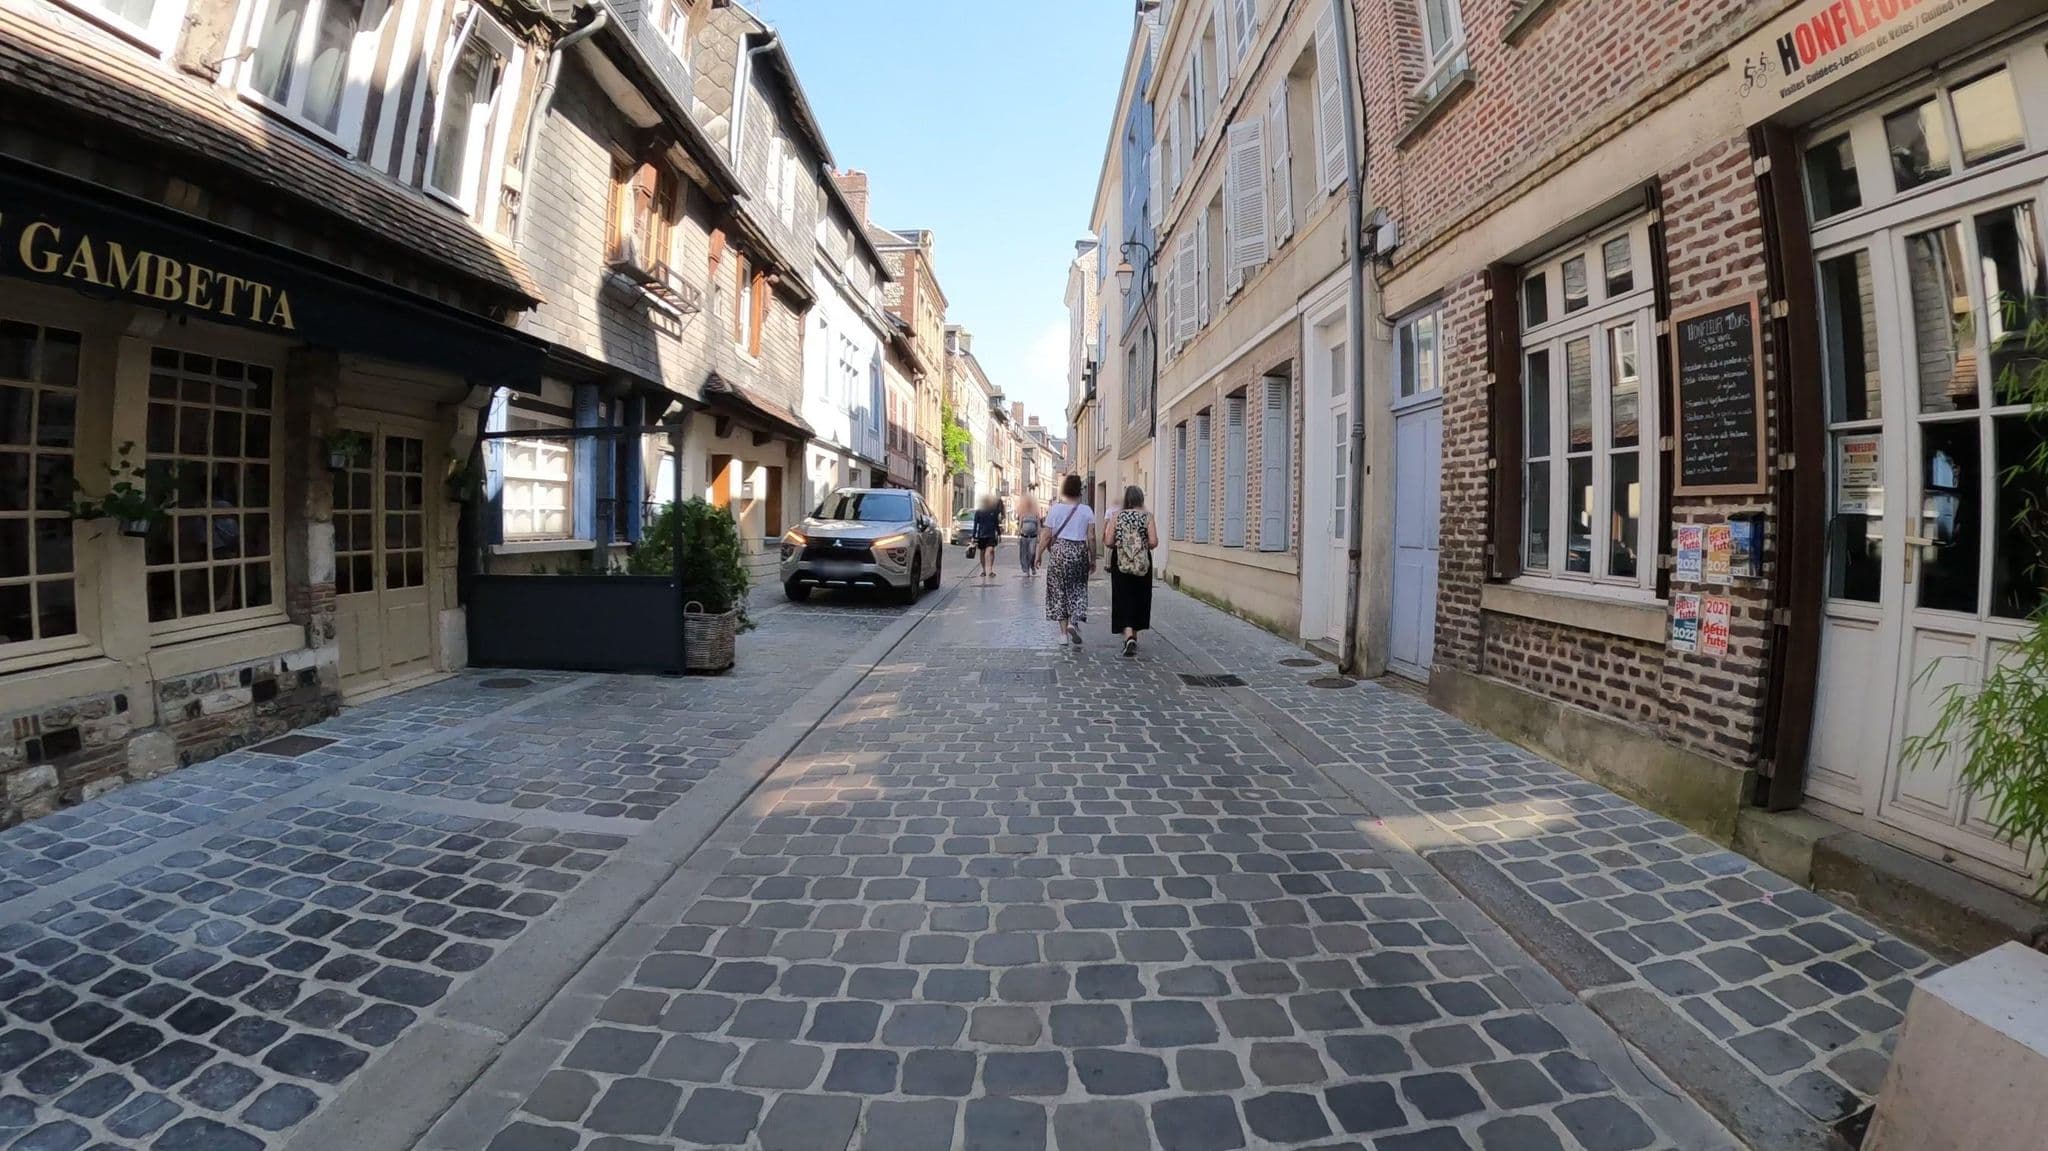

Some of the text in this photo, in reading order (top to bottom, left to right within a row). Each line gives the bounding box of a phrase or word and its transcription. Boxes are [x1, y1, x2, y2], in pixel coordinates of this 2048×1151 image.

[19, 221, 295, 330] GAMBETTA
[1706, 600, 1729, 615] 2021
[1673, 627, 1697, 641] 2022
